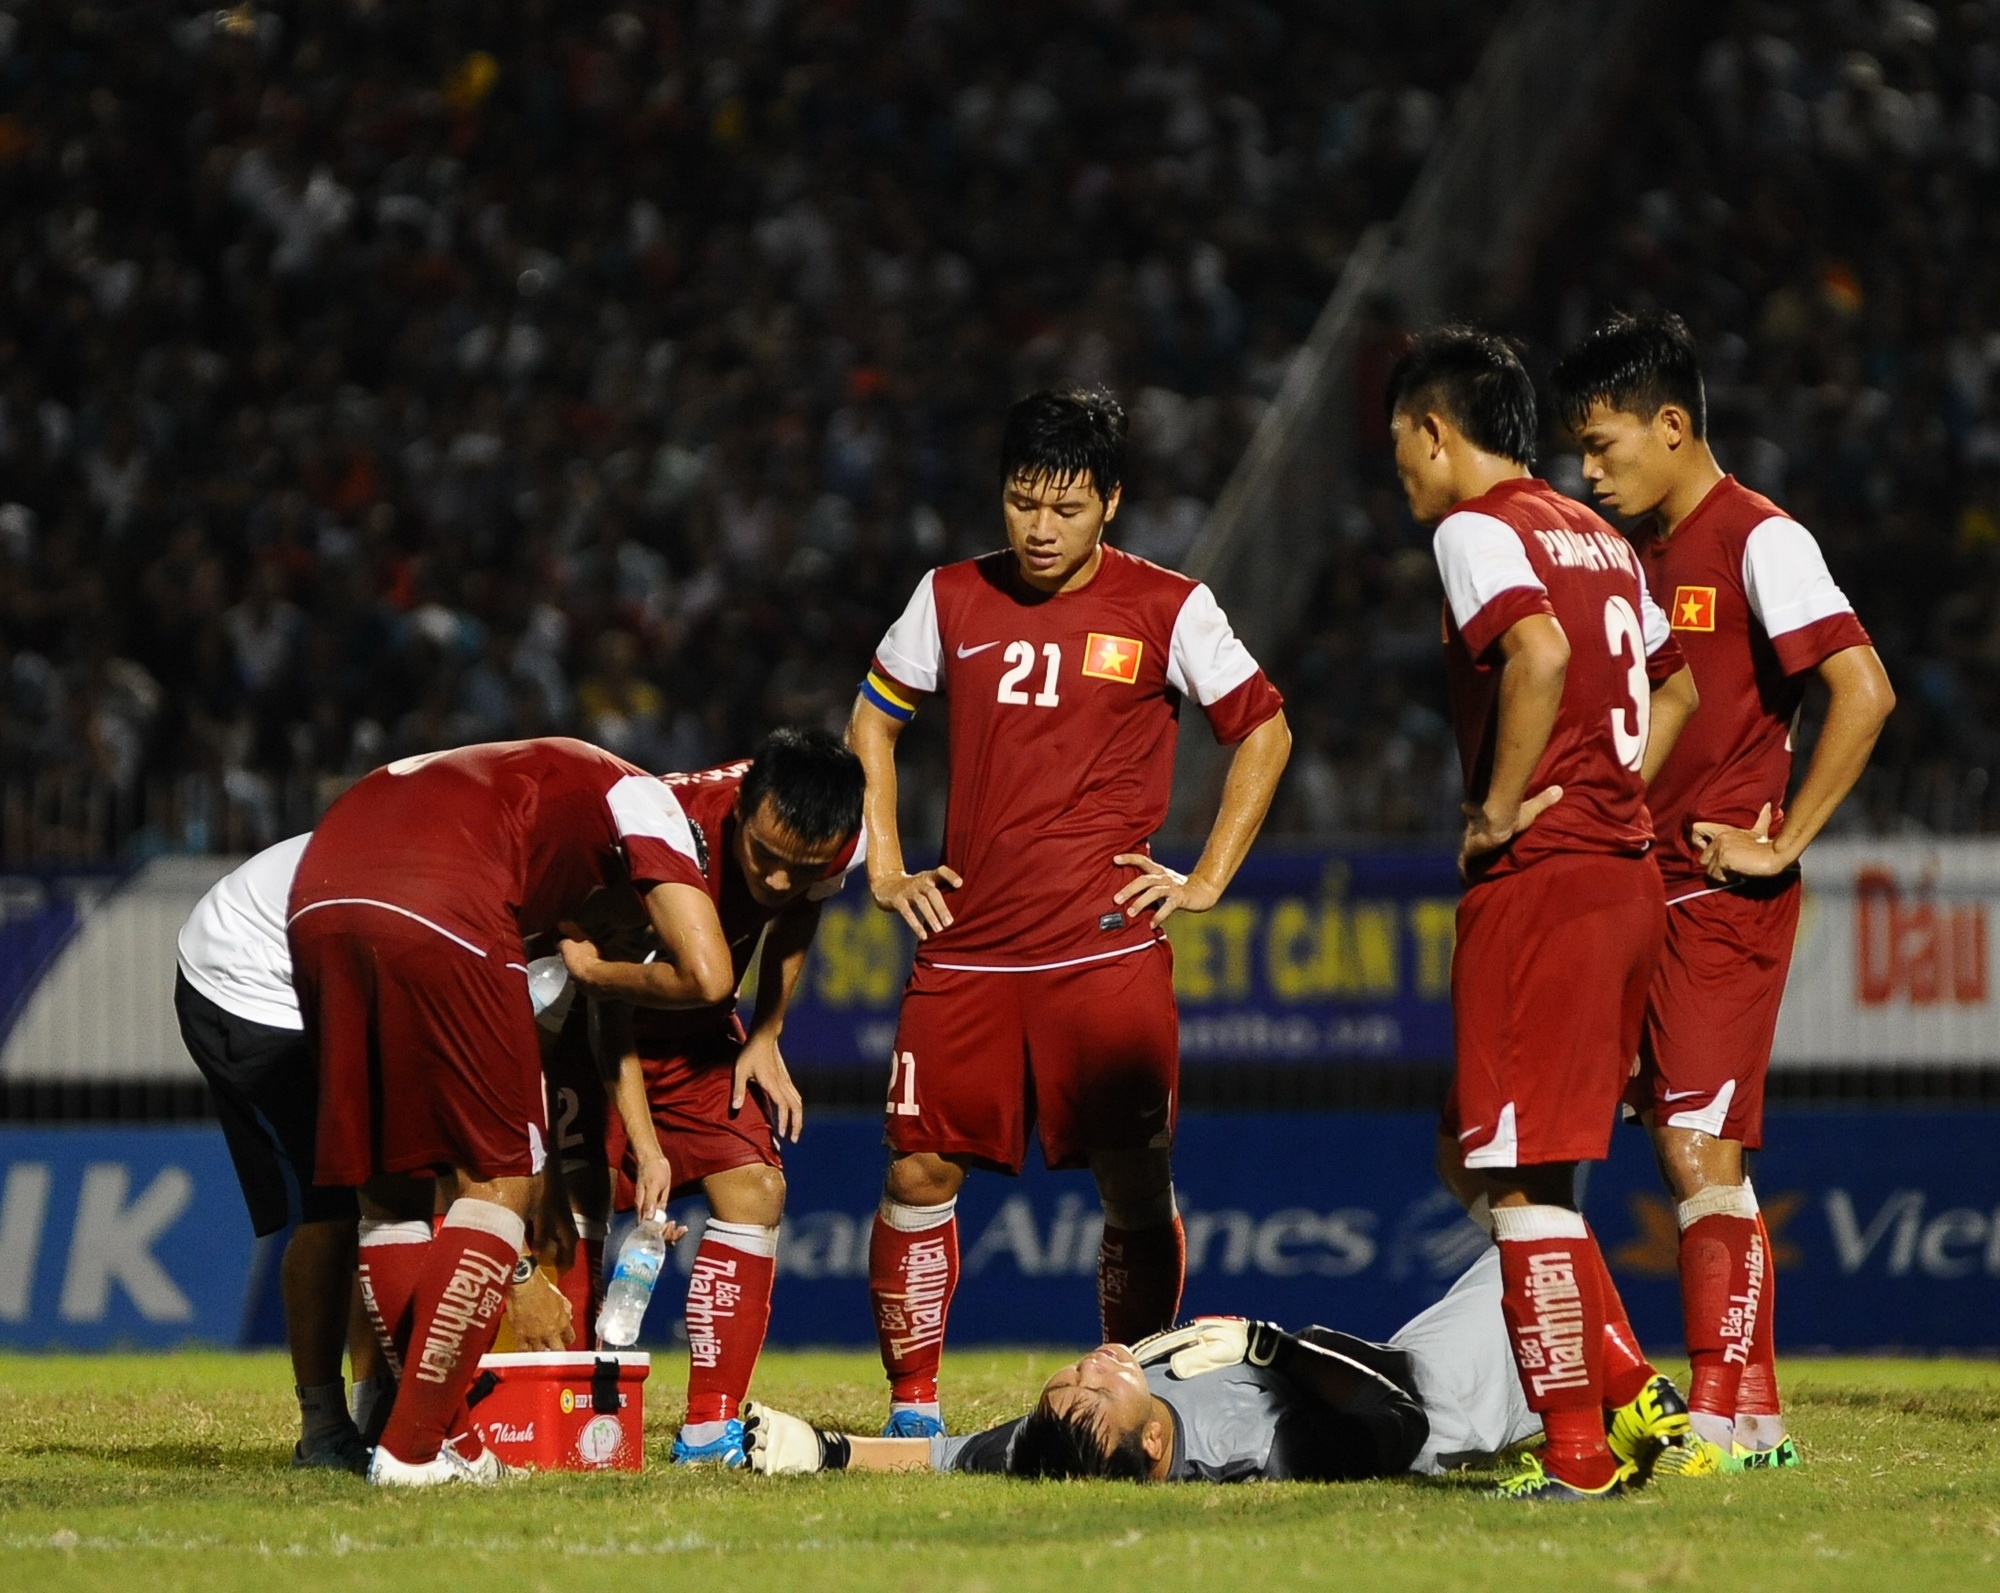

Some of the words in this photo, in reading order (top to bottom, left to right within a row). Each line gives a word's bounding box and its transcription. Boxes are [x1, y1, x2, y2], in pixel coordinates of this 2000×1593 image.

[997, 640, 1061, 707] 21
[1604, 595, 1650, 772] 3
[715, 1280, 741, 1308] Báo
[1720, 1306, 1743, 1338] Báo
[1518, 1338, 1546, 1369] Báo
[489, 1421, 535, 1444] Thành
